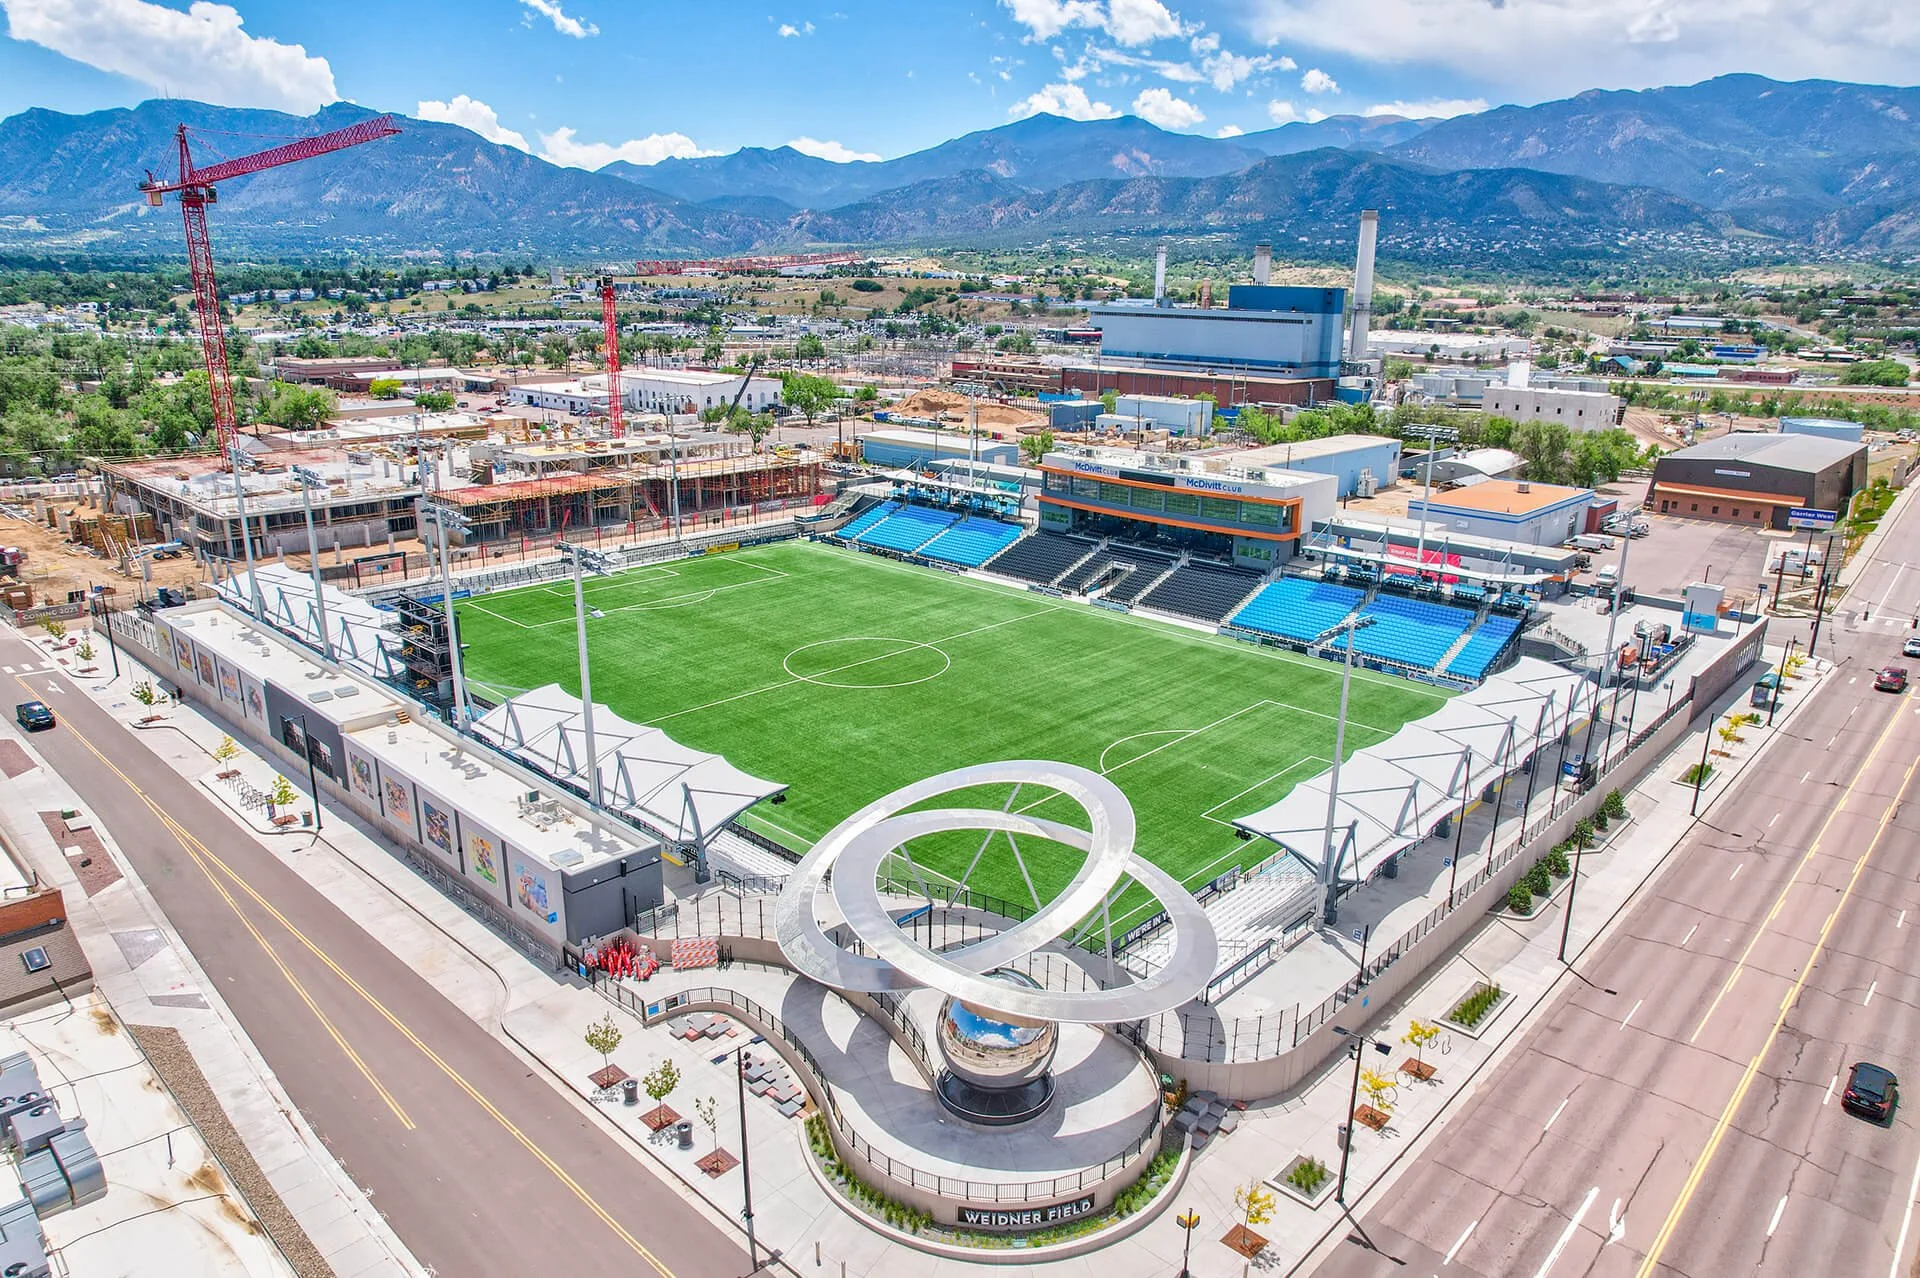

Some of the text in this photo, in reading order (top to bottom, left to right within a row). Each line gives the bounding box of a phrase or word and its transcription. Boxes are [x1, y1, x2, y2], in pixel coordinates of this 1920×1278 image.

[1186, 478, 1221, 490] McDivitt
[1223, 485, 1242, 493] CLUB
[965, 1201, 1091, 1226] WEIDNER FIELD
